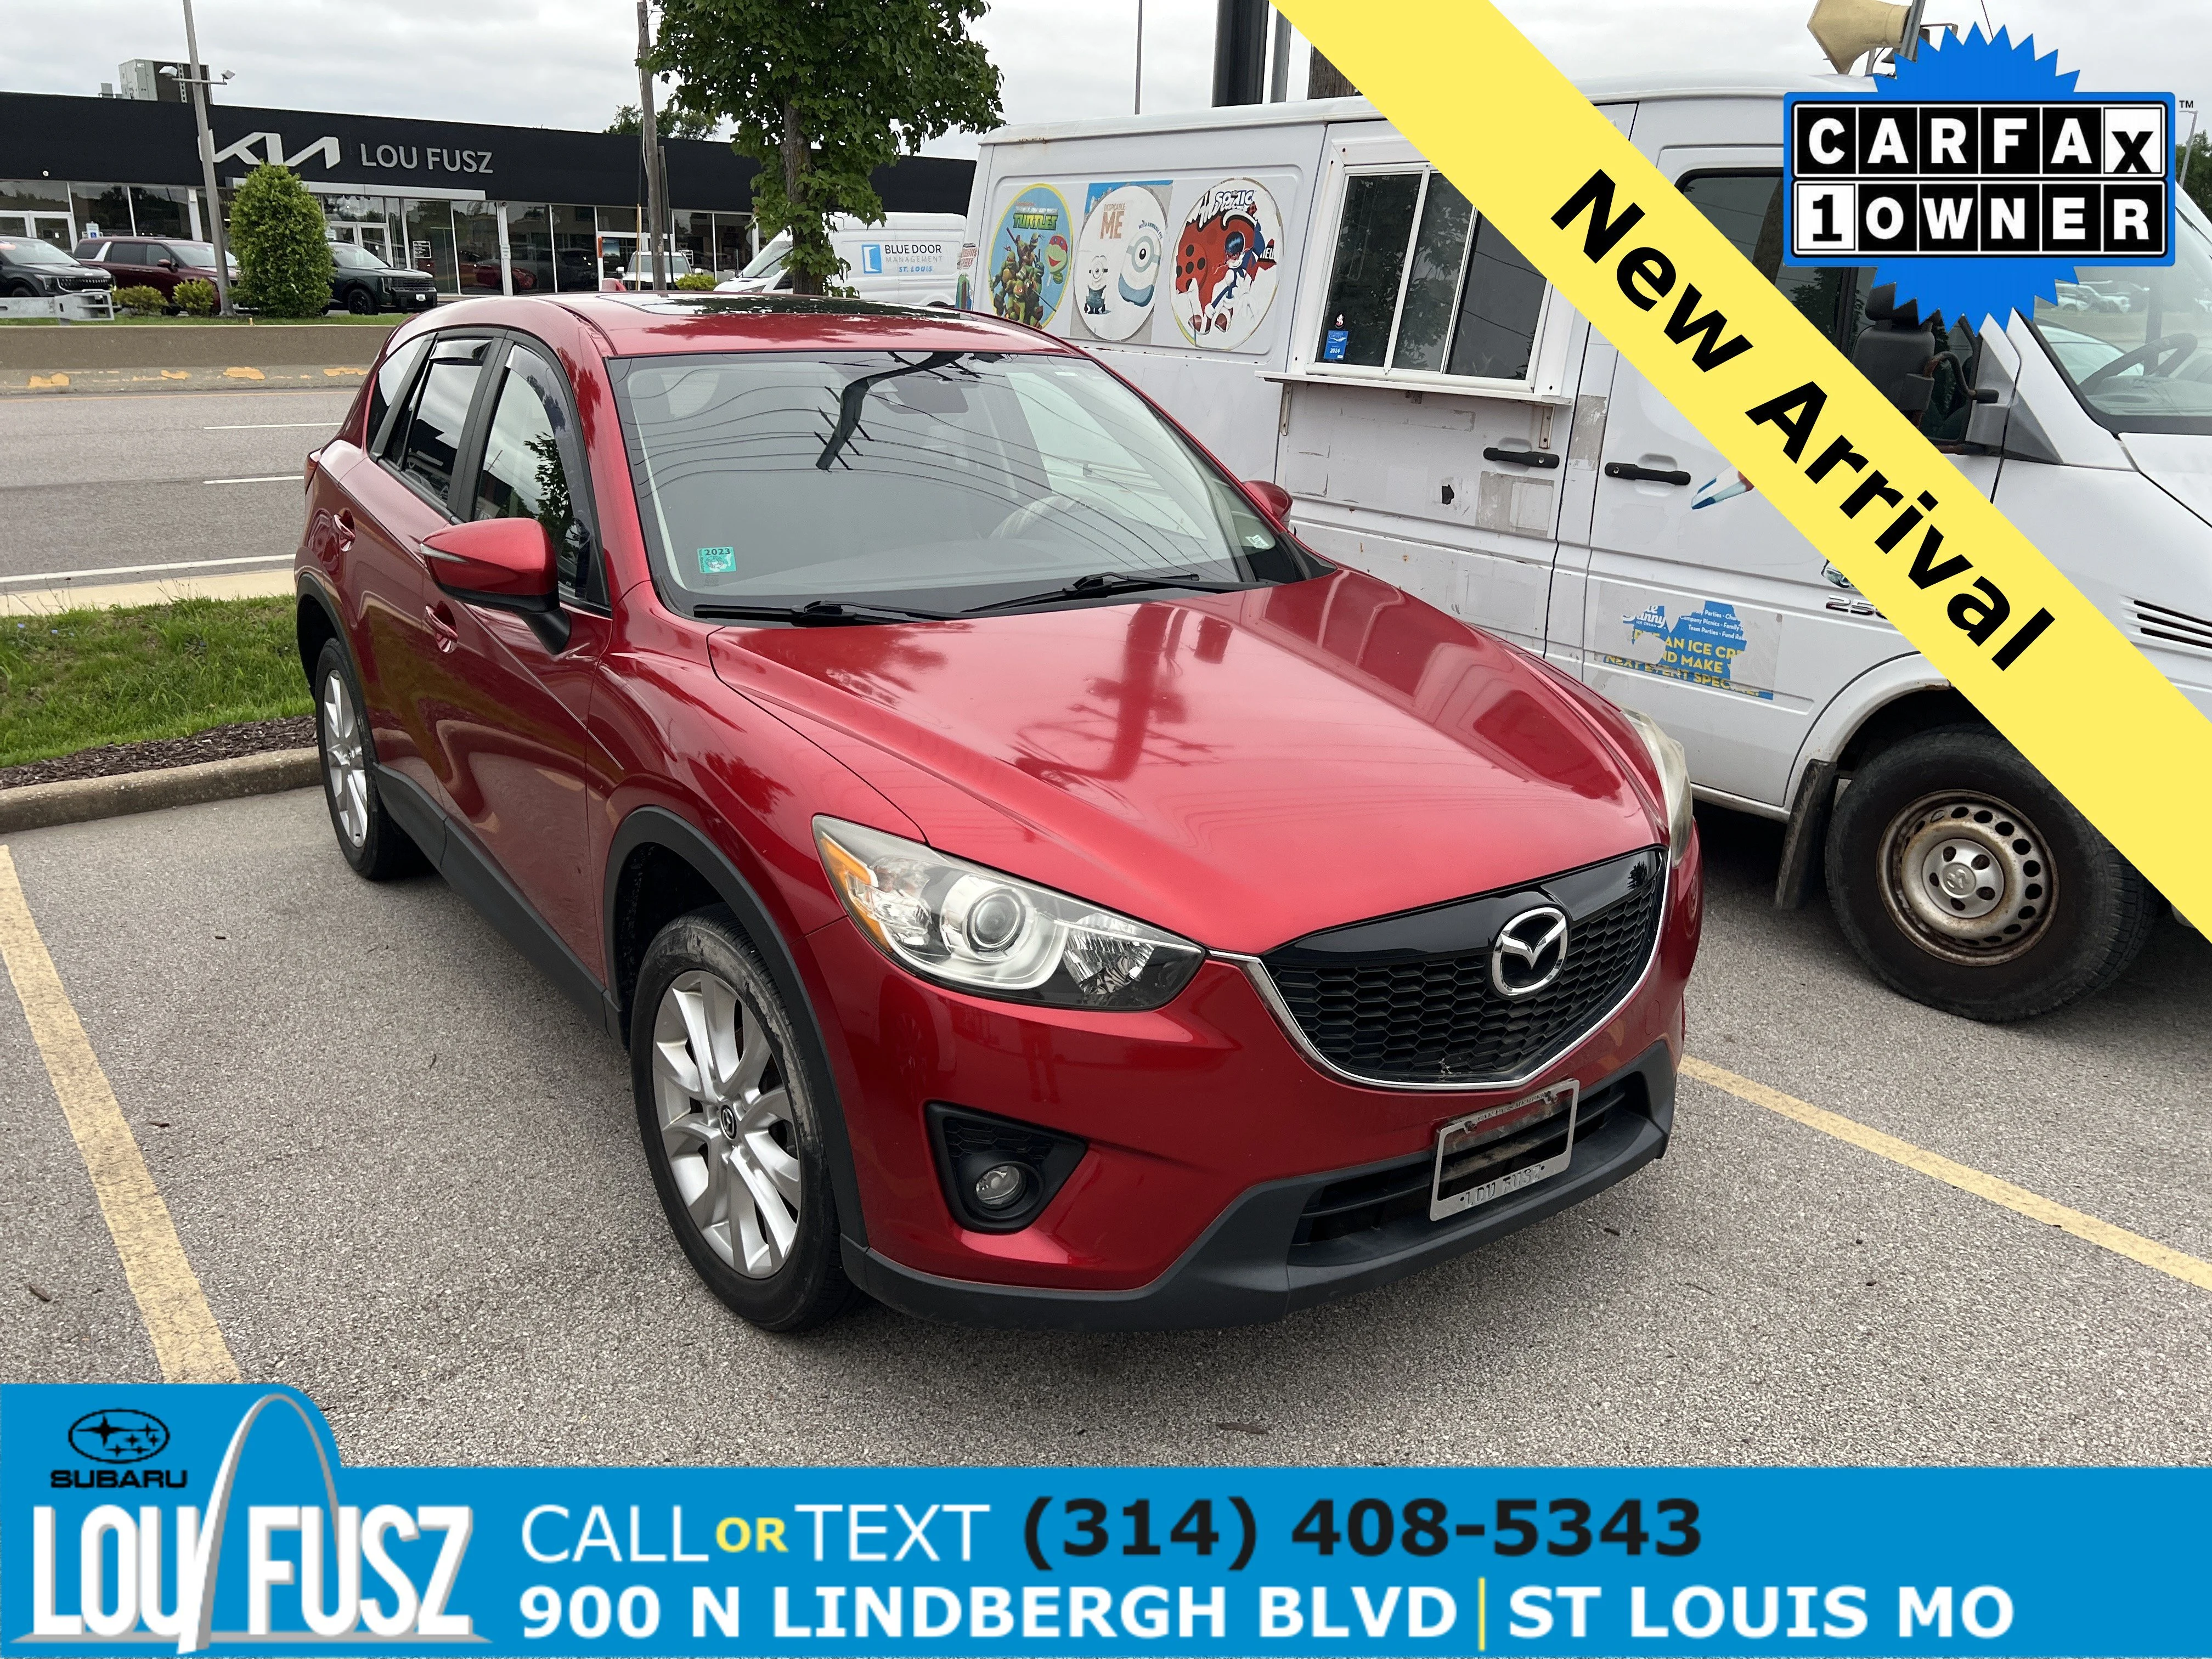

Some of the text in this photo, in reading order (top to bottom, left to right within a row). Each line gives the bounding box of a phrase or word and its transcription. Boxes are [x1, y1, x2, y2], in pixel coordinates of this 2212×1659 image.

[360, 143, 493, 173] LOU FUSZ
[1013, 213, 1058, 230] TURTLES
[1100, 211, 1125, 239] ME
[885, 244, 942, 254] BLUE DOOR
[1705, 610, 1722, 618] Parties
[1680, 616, 1702, 624] Company
[1703, 618, 1720, 627] Picnics
[1723, 622, 1740, 631] Family
[1701, 627, 1718, 636] Parties
[1722, 631, 1735, 639] Fund
[1665, 636, 1684, 650] AN
[1688, 640, 1712, 656] ICE
[1681, 654, 1723, 674] MAKE
[1464, 1182, 1496, 1207] LOU
